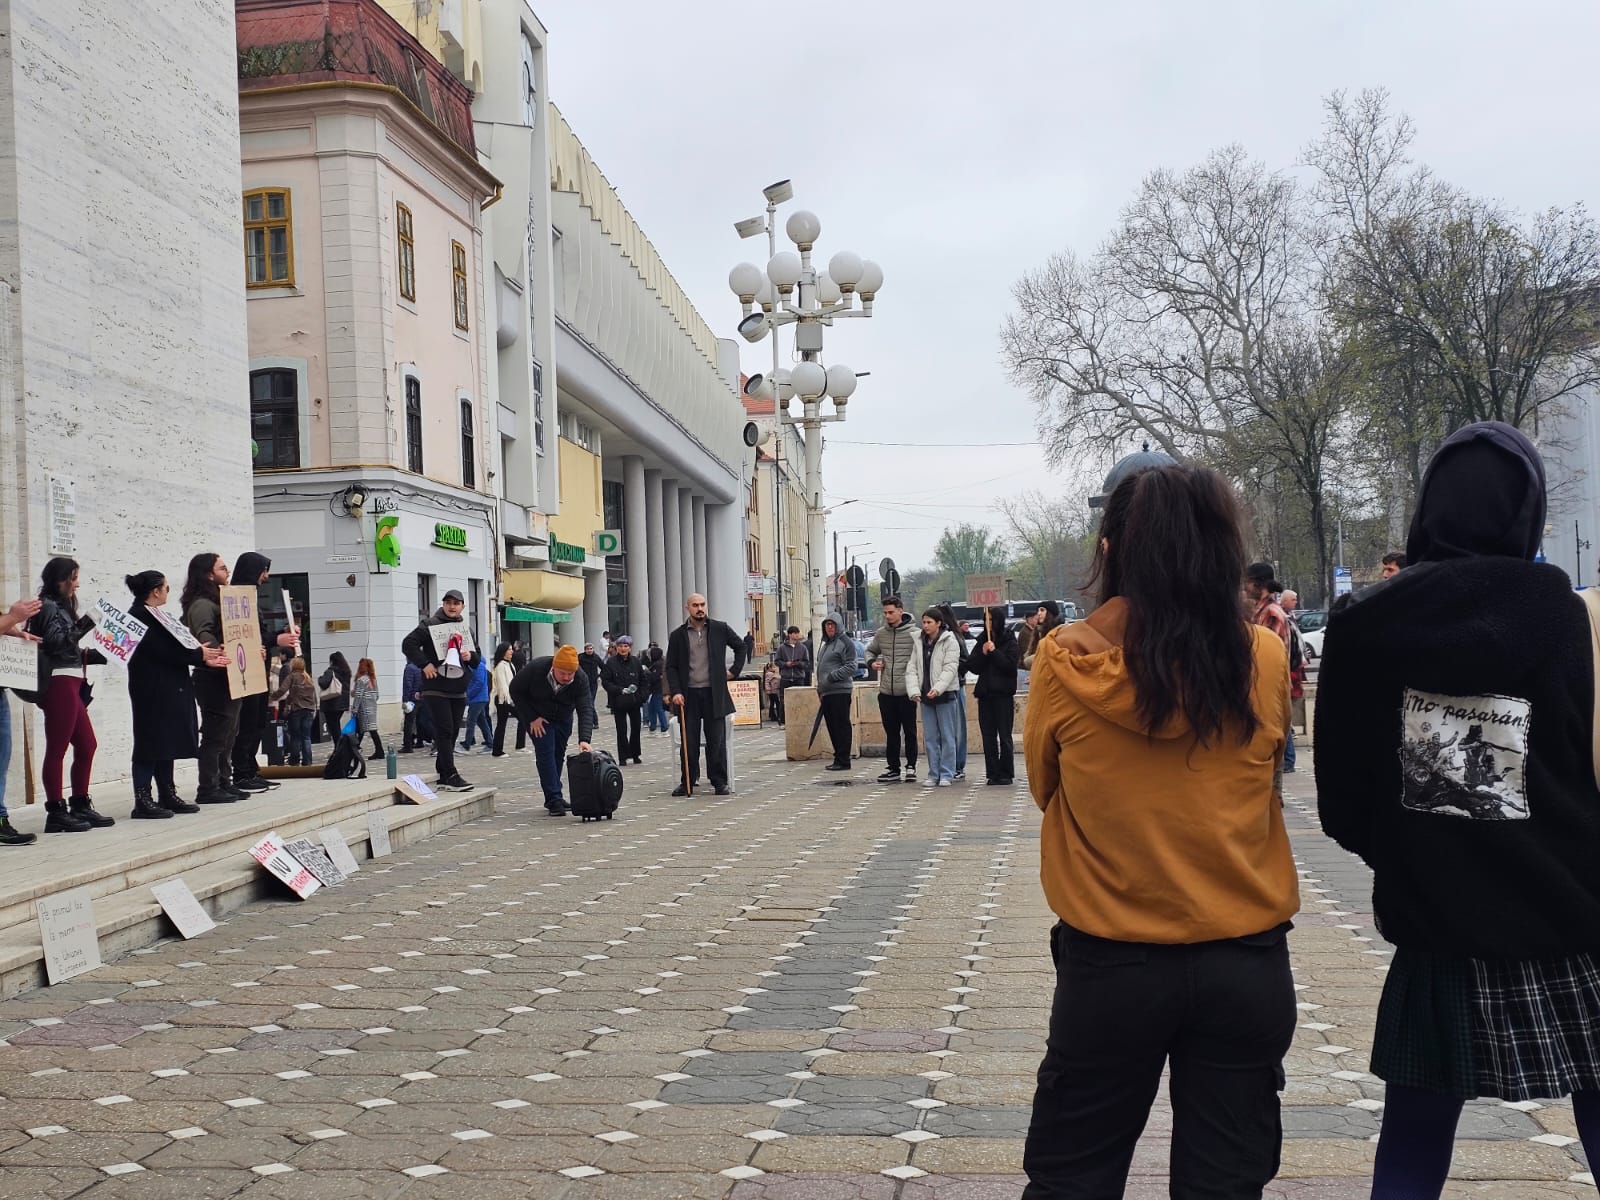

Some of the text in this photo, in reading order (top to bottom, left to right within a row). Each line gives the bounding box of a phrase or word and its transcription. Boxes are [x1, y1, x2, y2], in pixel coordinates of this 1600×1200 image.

[434, 522, 466, 546] SPARTAN
[598, 533, 618, 553] D
[97, 597, 127, 625] AVORTUL
[126, 620, 146, 637] ESTE
[269, 856, 293, 879] NU
